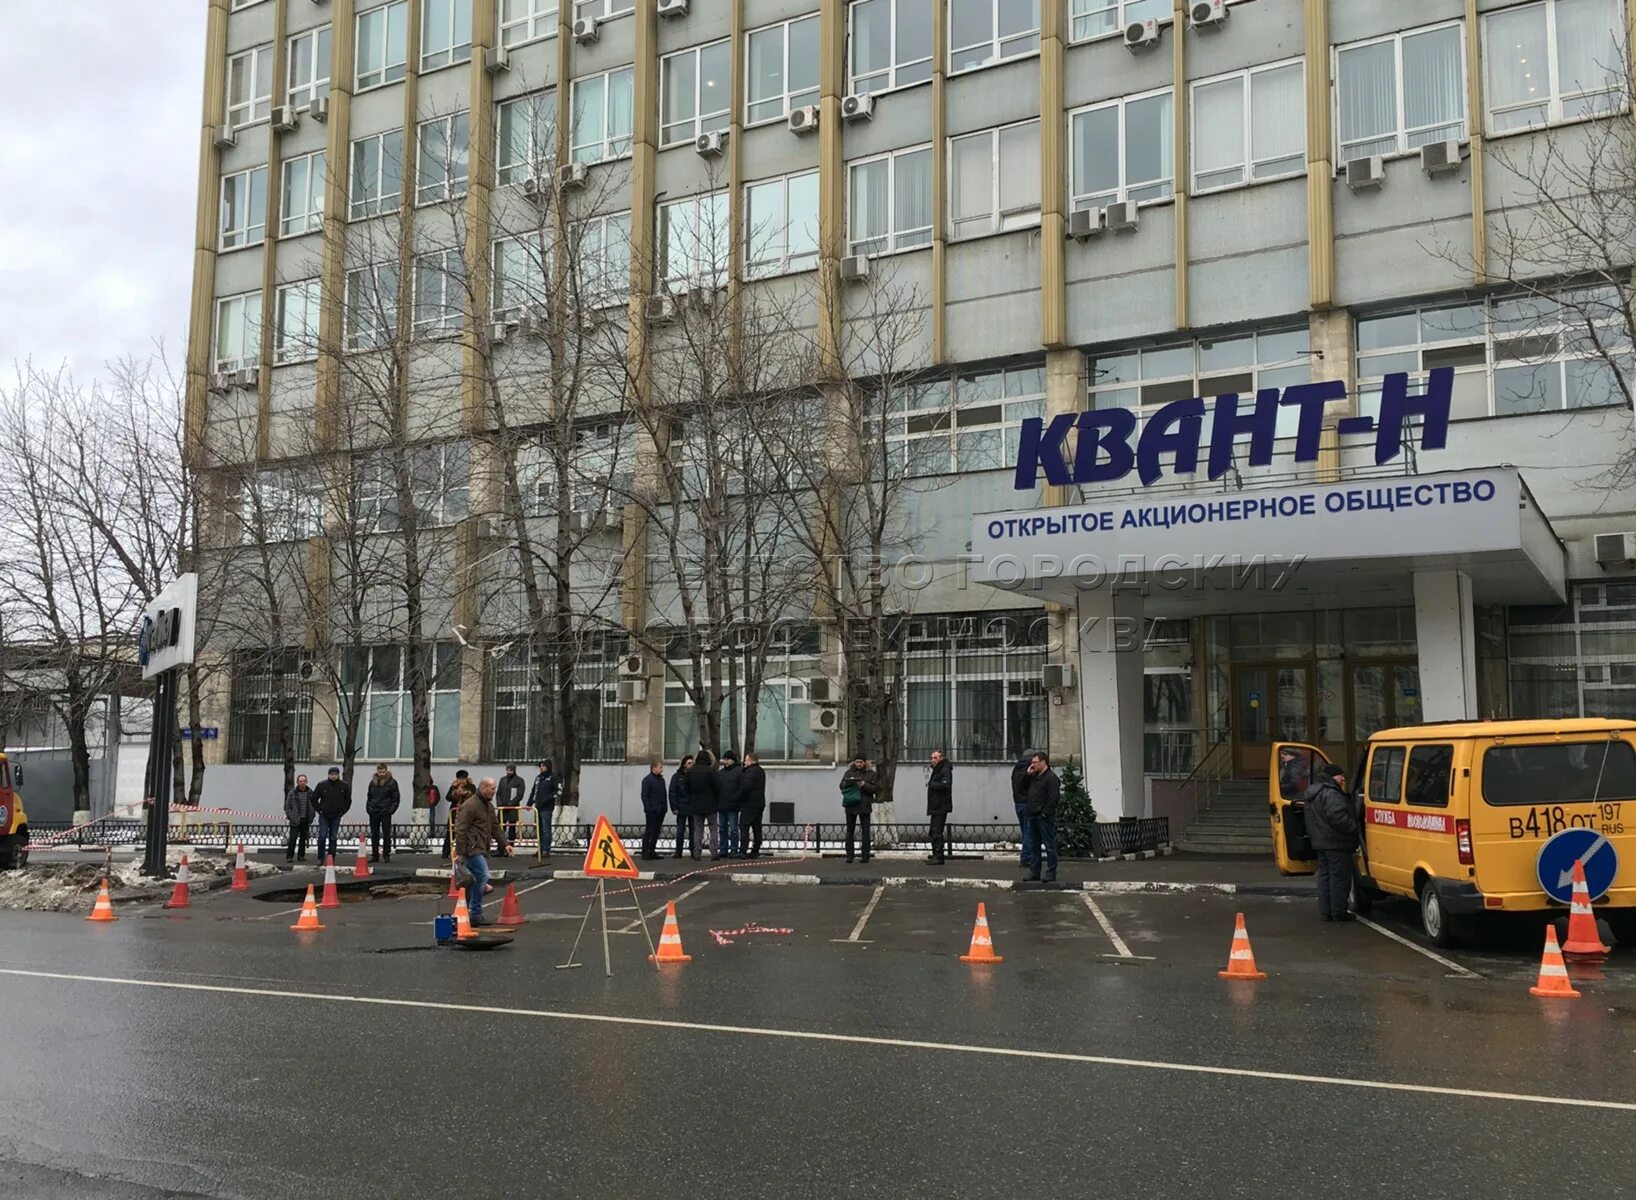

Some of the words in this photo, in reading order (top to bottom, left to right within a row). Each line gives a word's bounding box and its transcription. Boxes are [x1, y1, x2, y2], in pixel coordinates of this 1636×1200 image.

[1014, 366, 1456, 490] КВАНТ-Н
[988, 511, 1114, 539] ОТКРЫТОЕ
[1120, 494, 1316, 530] АКЦИОНЕРНОЕ
[1324, 479, 1496, 513] ОБЩЕСТВО
[1598, 803, 1622, 821] 197
[1601, 823, 1625, 835] RUS
